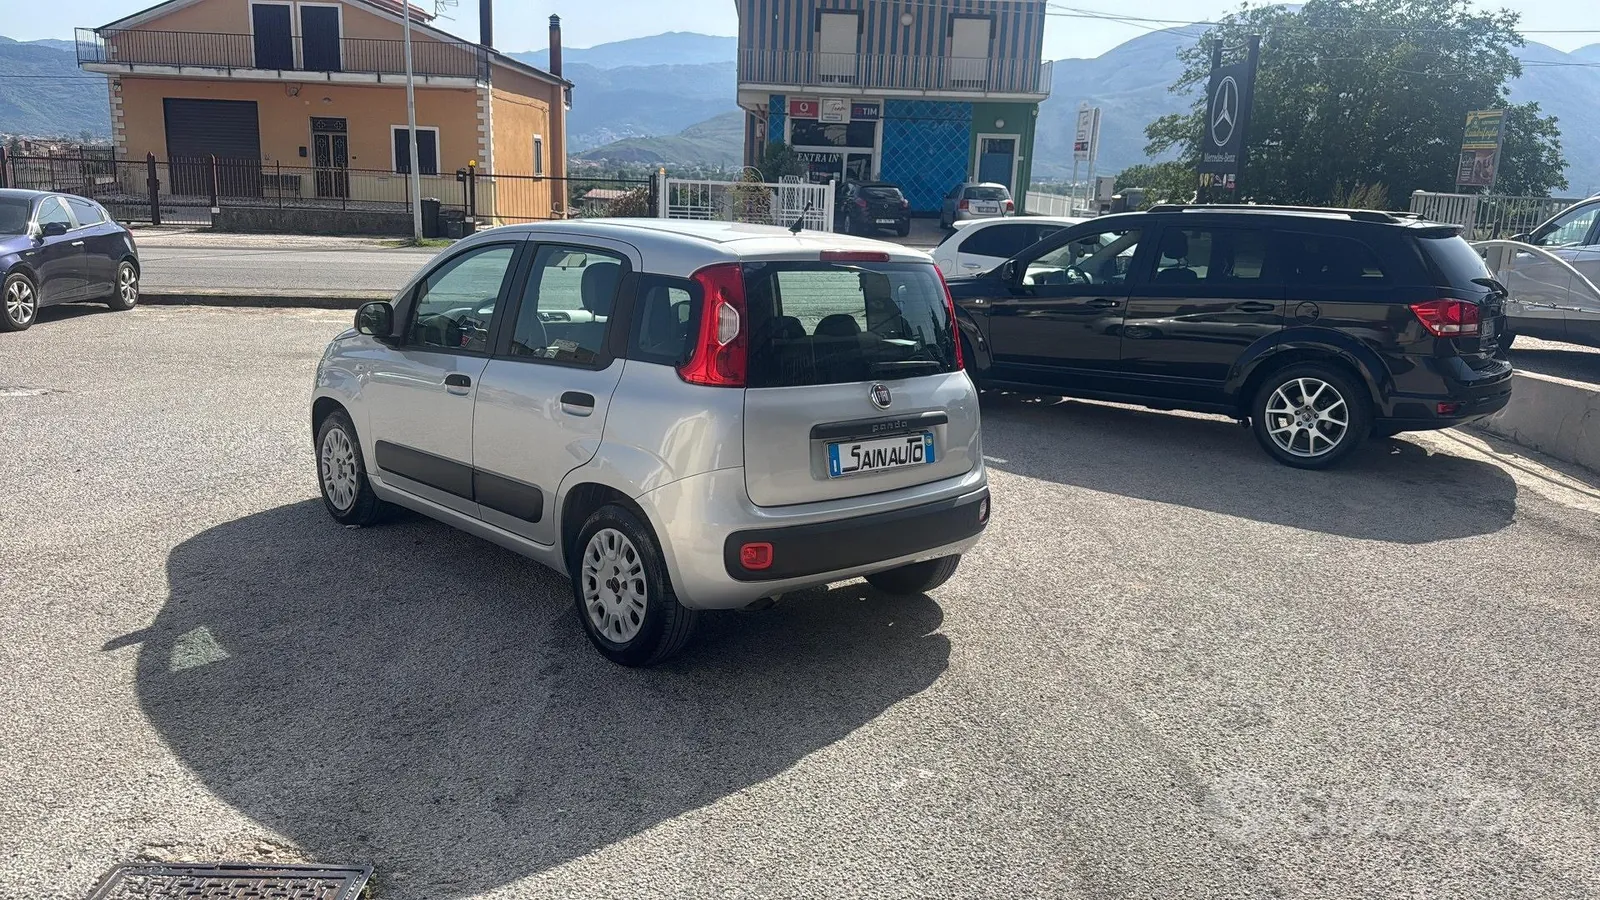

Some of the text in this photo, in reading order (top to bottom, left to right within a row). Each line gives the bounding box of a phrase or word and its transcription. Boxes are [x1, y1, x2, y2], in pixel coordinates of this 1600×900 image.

[862, 108, 877, 116] TIM
[797, 153, 839, 162] ENTRA IN
[876, 390, 890, 402] FIAT
[872, 420, 908, 432] panda
